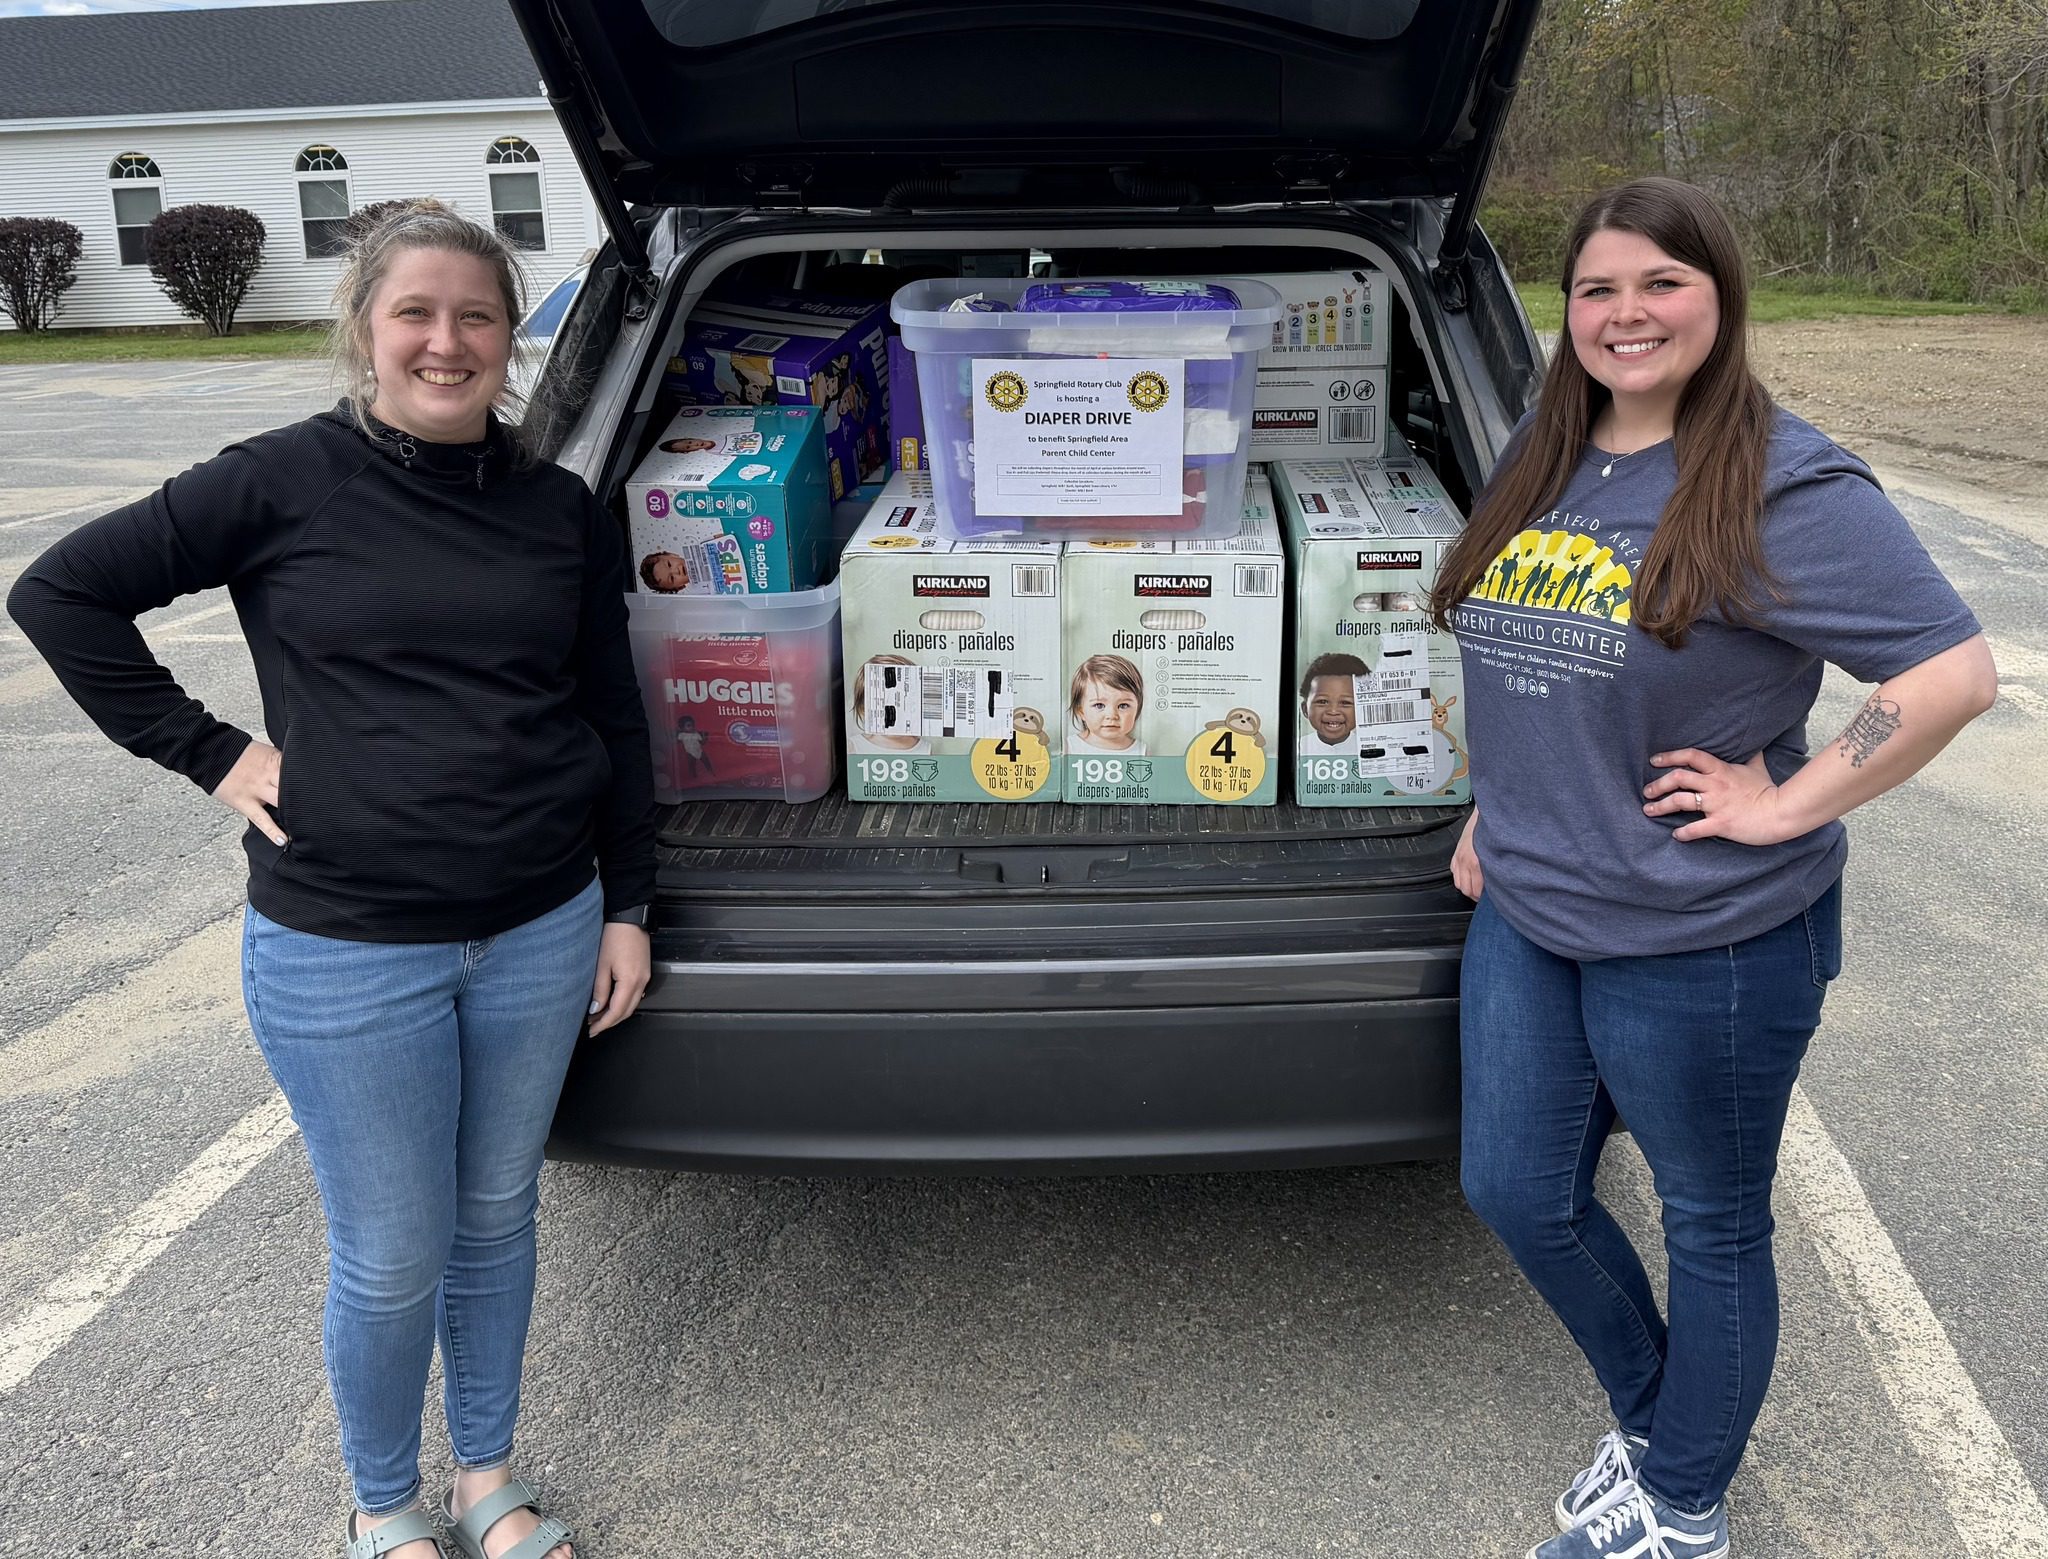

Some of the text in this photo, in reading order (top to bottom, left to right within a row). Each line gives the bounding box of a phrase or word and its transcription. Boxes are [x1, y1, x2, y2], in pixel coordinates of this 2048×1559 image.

[1275, 305, 1371, 331] 1 2 3 4 5 6
[1034, 381, 1076, 389] Springfield
[1078, 381, 1103, 389] Rotary
[1065, 396, 1093, 404] hosting
[1025, 413, 1132, 425] DIAPER DRIVE
[1256, 412, 1316, 422] KIRKLAND
[1068, 436, 1109, 444] Springfield
[904, 440, 915, 471] 4T-5
[649, 496, 661, 512] 80
[749, 521, 761, 530] 3
[1539, 511, 1643, 570] FIELD AREA
[749, 549, 757, 578] premium
[1360, 552, 1419, 563] KIRKLAND
[717, 539, 744, 594] STEPS
[755, 543, 769, 589] diapers
[918, 577, 987, 589] KIRKLAND
[1139, 577, 1209, 588] KIRKLAND
[917, 589, 987, 598] Signature
[1138, 588, 1209, 597] Signature
[1336, 619, 1381, 638] diapers
[894, 630, 1014, 653] diapers pañales
[1113, 630, 1234, 653] diapers pañales
[1502, 620, 1544, 641] CHILD
[1552, 627, 1626, 658] CENTER
[1498, 648, 1517, 660] Support
[1518, 651, 1526, 660] for
[1574, 664, 1614, 679] Caregivers
[665, 678, 795, 705] HUGGIES
[718, 706, 748, 716] little
[996, 731, 1021, 762] 4
[1211, 732, 1237, 763] 4
[858, 759, 909, 782] 198
[986, 765, 996, 777] 22
[998, 764, 1007, 776] lbs
[1015, 765, 1024, 777] 37
[1026, 764, 1036, 777] lbs
[1072, 760, 1123, 783] 198
[1200, 766, 1210, 778] 22
[1212, 766, 1222, 778] lbs
[1229, 766, 1238, 778] 37
[1240, 766, 1251, 778] lbs
[1303, 759, 1348, 780] 168
[989, 778, 996, 788] 10
[1000, 778, 1009, 791] kg
[1016, 778, 1022, 788] 17
[1025, 778, 1033, 791] kg
[1203, 779, 1210, 790] 10
[1213, 779, 1222, 792] kg
[1230, 780, 1236, 791] 17
[1239, 779, 1248, 793] kg
[1307, 781, 1372, 795] diapers pañales
[1407, 776, 1414, 788] 12
[1415, 776, 1424, 789] kg
[864, 783, 936, 798] diapers pañales
[1078, 784, 1149, 799] diapers pañales
